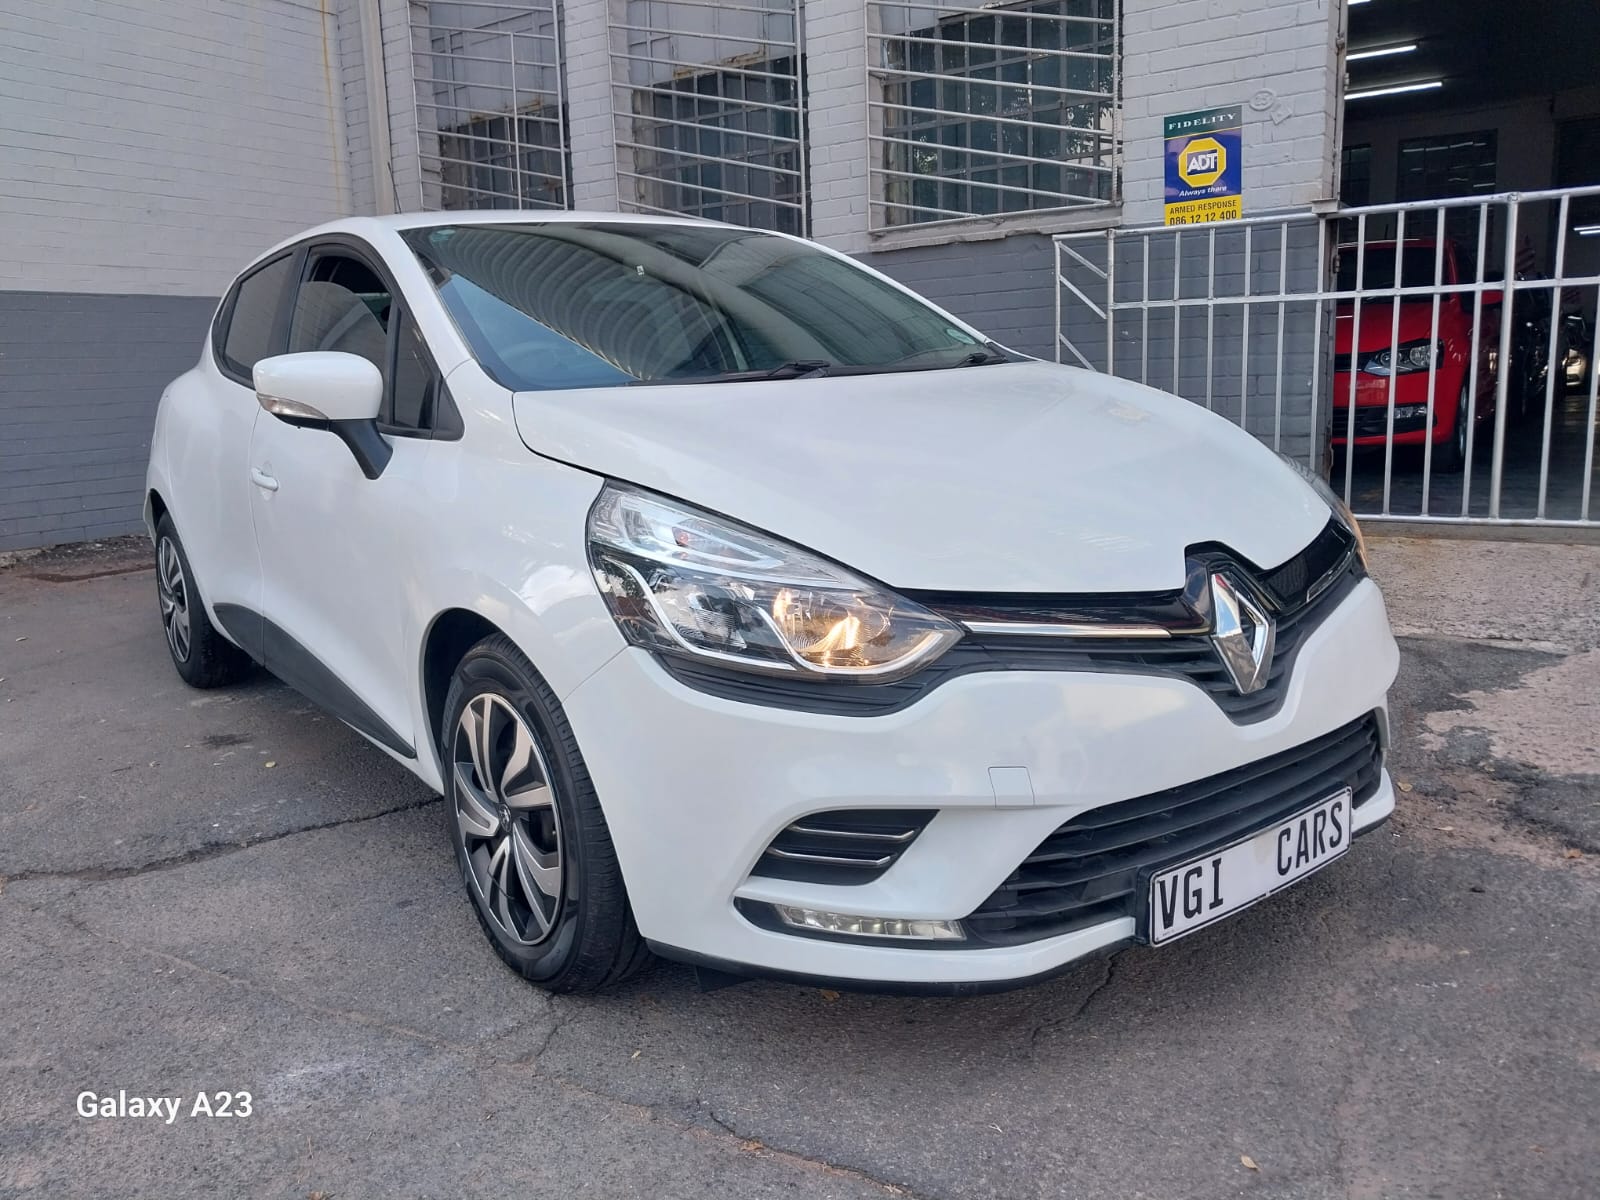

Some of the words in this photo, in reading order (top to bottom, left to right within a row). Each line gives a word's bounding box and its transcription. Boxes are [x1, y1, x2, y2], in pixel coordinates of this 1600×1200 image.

[1168, 113, 1236, 130] FIDELITY
[1187, 152, 1218, 172] ADT
[1179, 189, 1206, 197] Always
[1170, 205, 1195, 215] ARMED
[1198, 200, 1237, 211] RESPONSE
[1169, 216, 1187, 226] 086
[1190, 214, 1201, 224] 12
[1205, 212, 1216, 222] 12
[1220, 210, 1237, 220] 400
[1159, 857, 1224, 930] VGI
[1276, 801, 1343, 876] CARS
